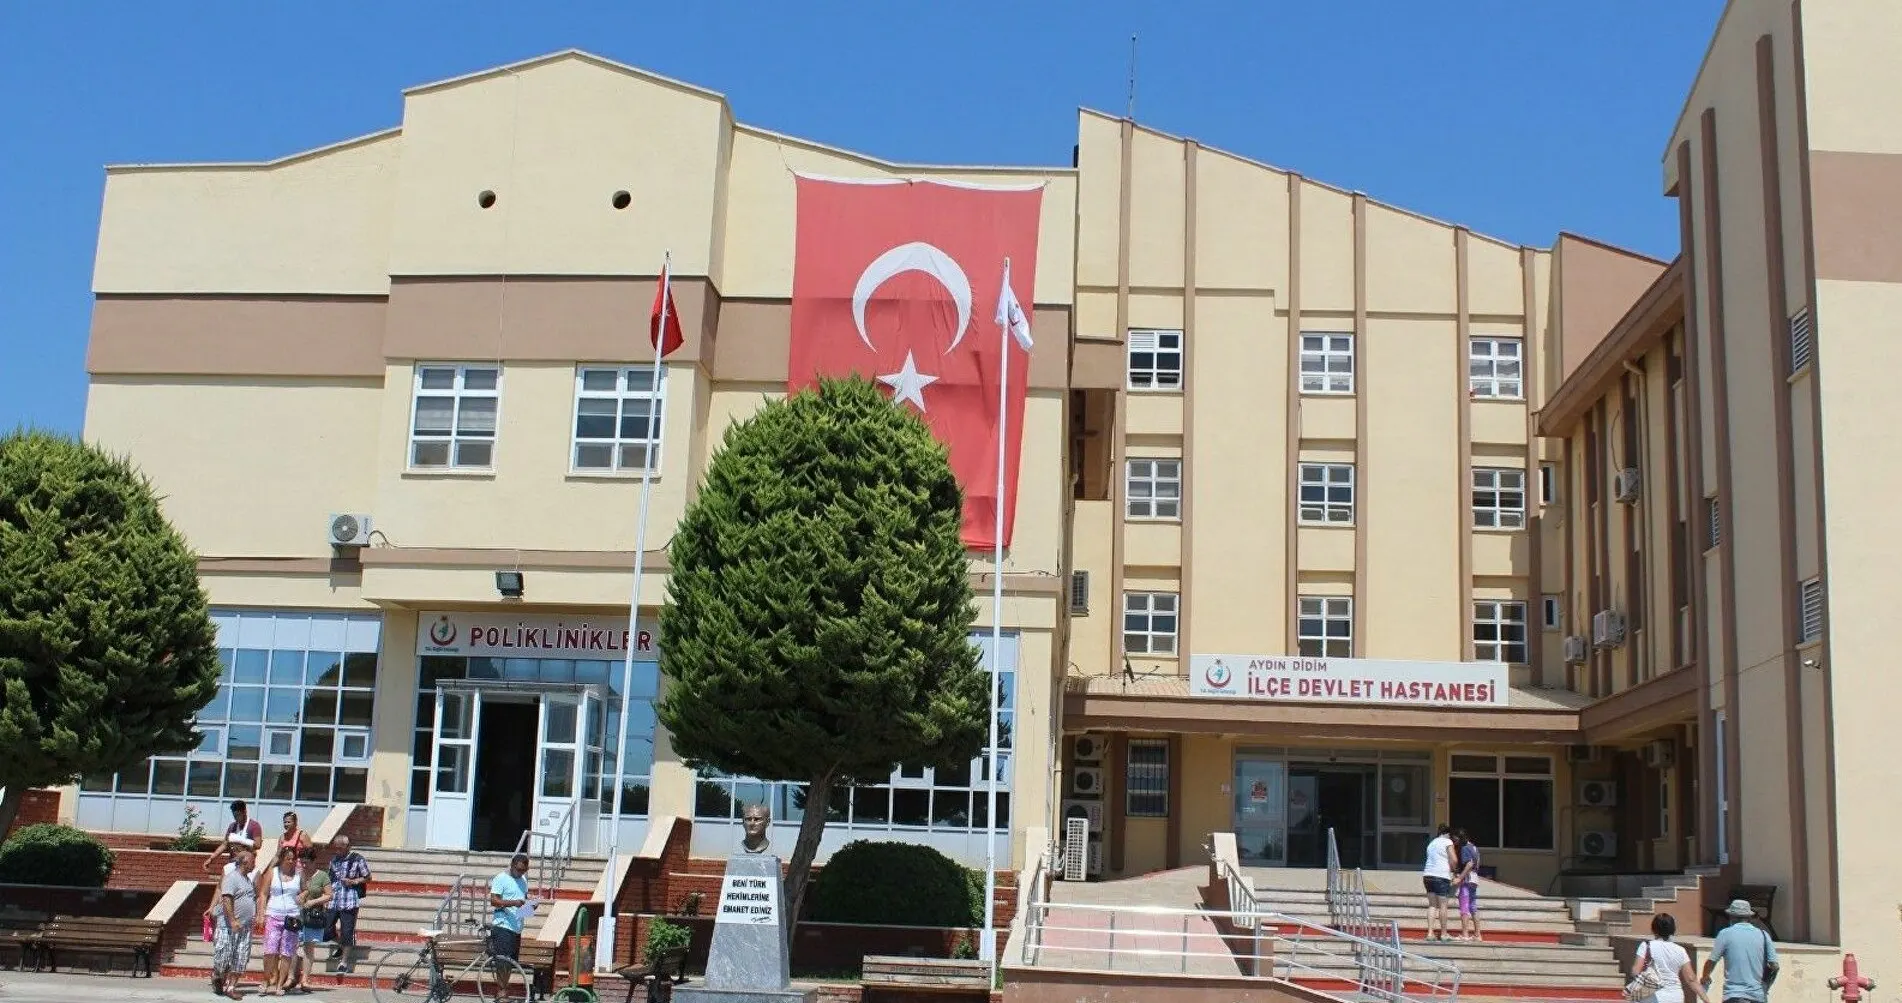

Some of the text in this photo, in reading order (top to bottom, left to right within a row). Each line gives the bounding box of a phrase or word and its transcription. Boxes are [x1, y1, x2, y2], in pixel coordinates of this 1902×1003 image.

[470, 622, 651, 650] POLİKLİNİKLER
[1249, 660, 1327, 672] AYDIN DİDİM
[1248, 672, 1495, 702] İLÇE DEVLET HASTANESİ
[749, 879, 767, 888] TÜRK
